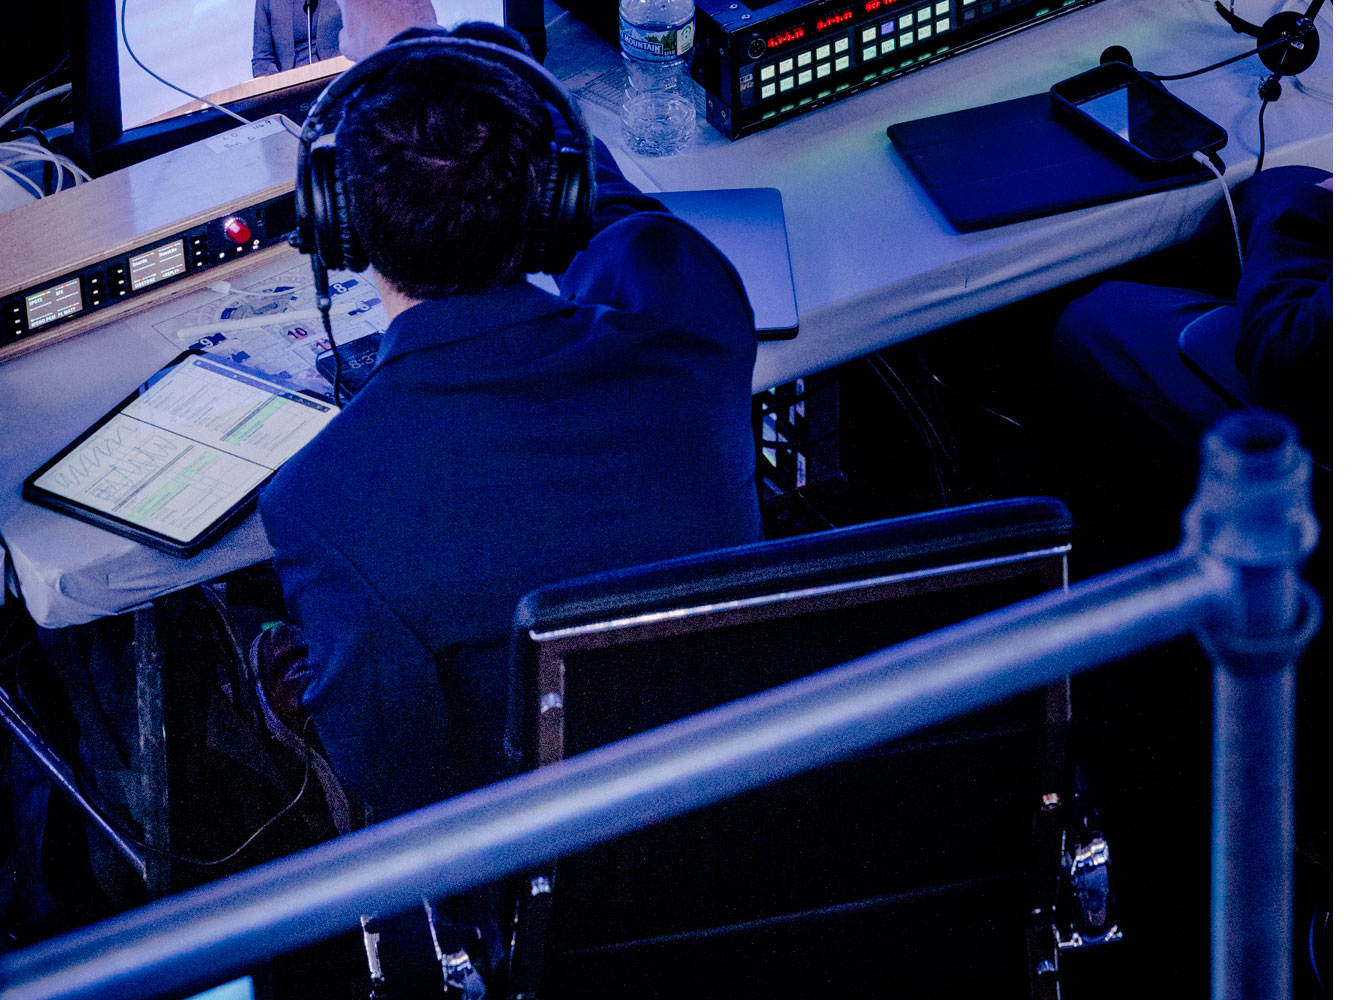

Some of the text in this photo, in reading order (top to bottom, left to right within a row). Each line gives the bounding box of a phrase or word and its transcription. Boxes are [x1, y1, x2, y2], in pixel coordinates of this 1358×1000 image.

[624, 35, 662, 55] MOUNTAIN
[333, 283, 347, 293] 8
[288, 328, 308, 340] 10
